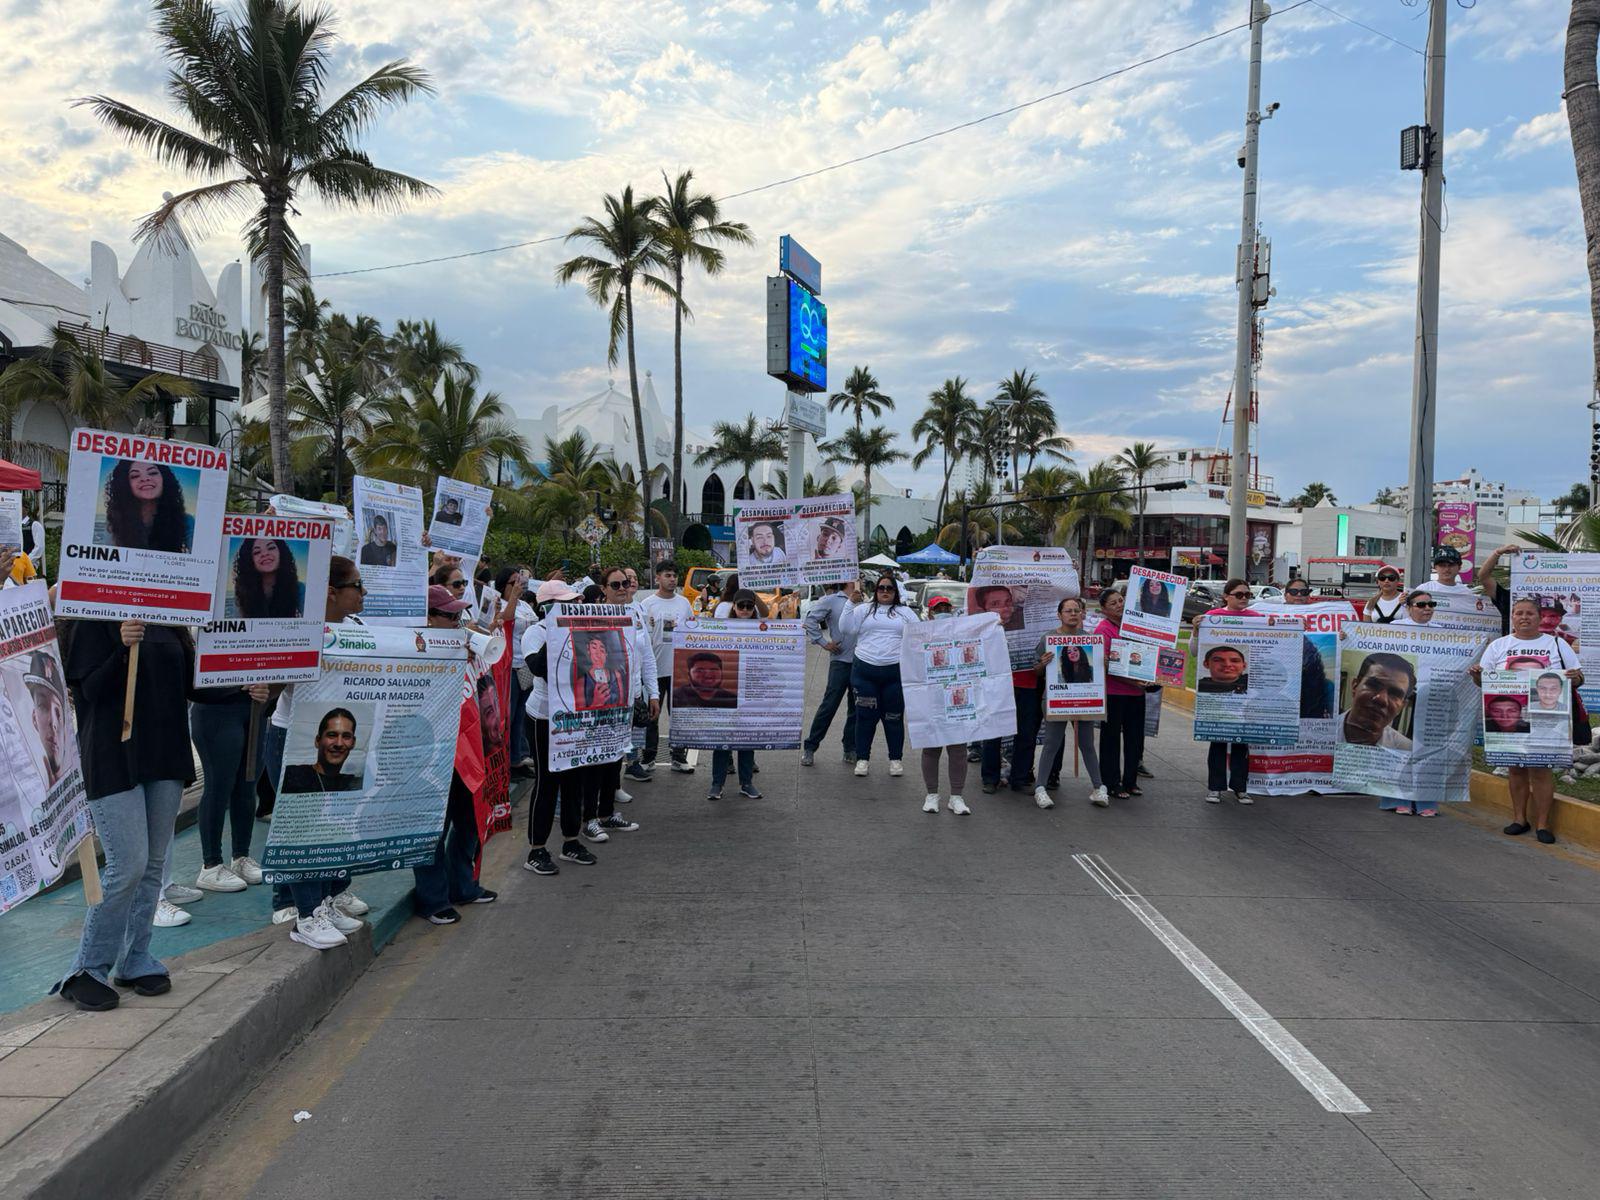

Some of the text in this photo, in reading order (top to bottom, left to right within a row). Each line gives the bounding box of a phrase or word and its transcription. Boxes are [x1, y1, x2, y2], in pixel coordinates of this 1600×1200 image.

[77, 432, 227, 471] DESAPARECIDA
[742, 509, 786, 517] DESAPARECIDO
[802, 503, 846, 514] DESAPARECIDO
[223, 517, 331, 540] ESAPARECIDA
[66, 544, 120, 562] CHINA
[1133, 566, 1187, 587] DESAPARECIDA
[1525, 575, 1573, 584] Ayúdanos
[62, 606, 205, 624] ¡Su familia la extraña mucho!
[561, 604, 626, 616] DESAPARECIDO
[1125, 609, 1144, 619] CHINA
[700, 623, 728, 631] Sinaloa
[1210, 629, 1247, 637] Ayúdanos
[686, 634, 734, 643] Ayúdanos
[745, 636, 788, 644] encontrar
[1356, 626, 1407, 640] Ayúdanos
[1420, 632, 1471, 643] encontrar
[338, 638, 377, 650] Sinaloa
[1048, 637, 1103, 646] DESAPARECIDA
[1357, 640, 1473, 657] OSCAR DAVID CRUZ MARTÍNEZ
[320, 659, 457, 673] Ayúdanos a encontrar a
[201, 671, 315, 685] ¡Su familia la extraña mucho!
[343, 677, 431, 687] RICARDO SALVADOR
[346, 691, 425, 701] AGUILAR MADERA
[267, 848, 276, 857] Si
[309, 844, 355, 855] información
[357, 840, 387, 850] referente
[413, 835, 440, 845] persona
[4, 848, 31, 871] CASA!
[356, 851, 376, 860] ayuda
[320, 870, 337, 878] 8424
